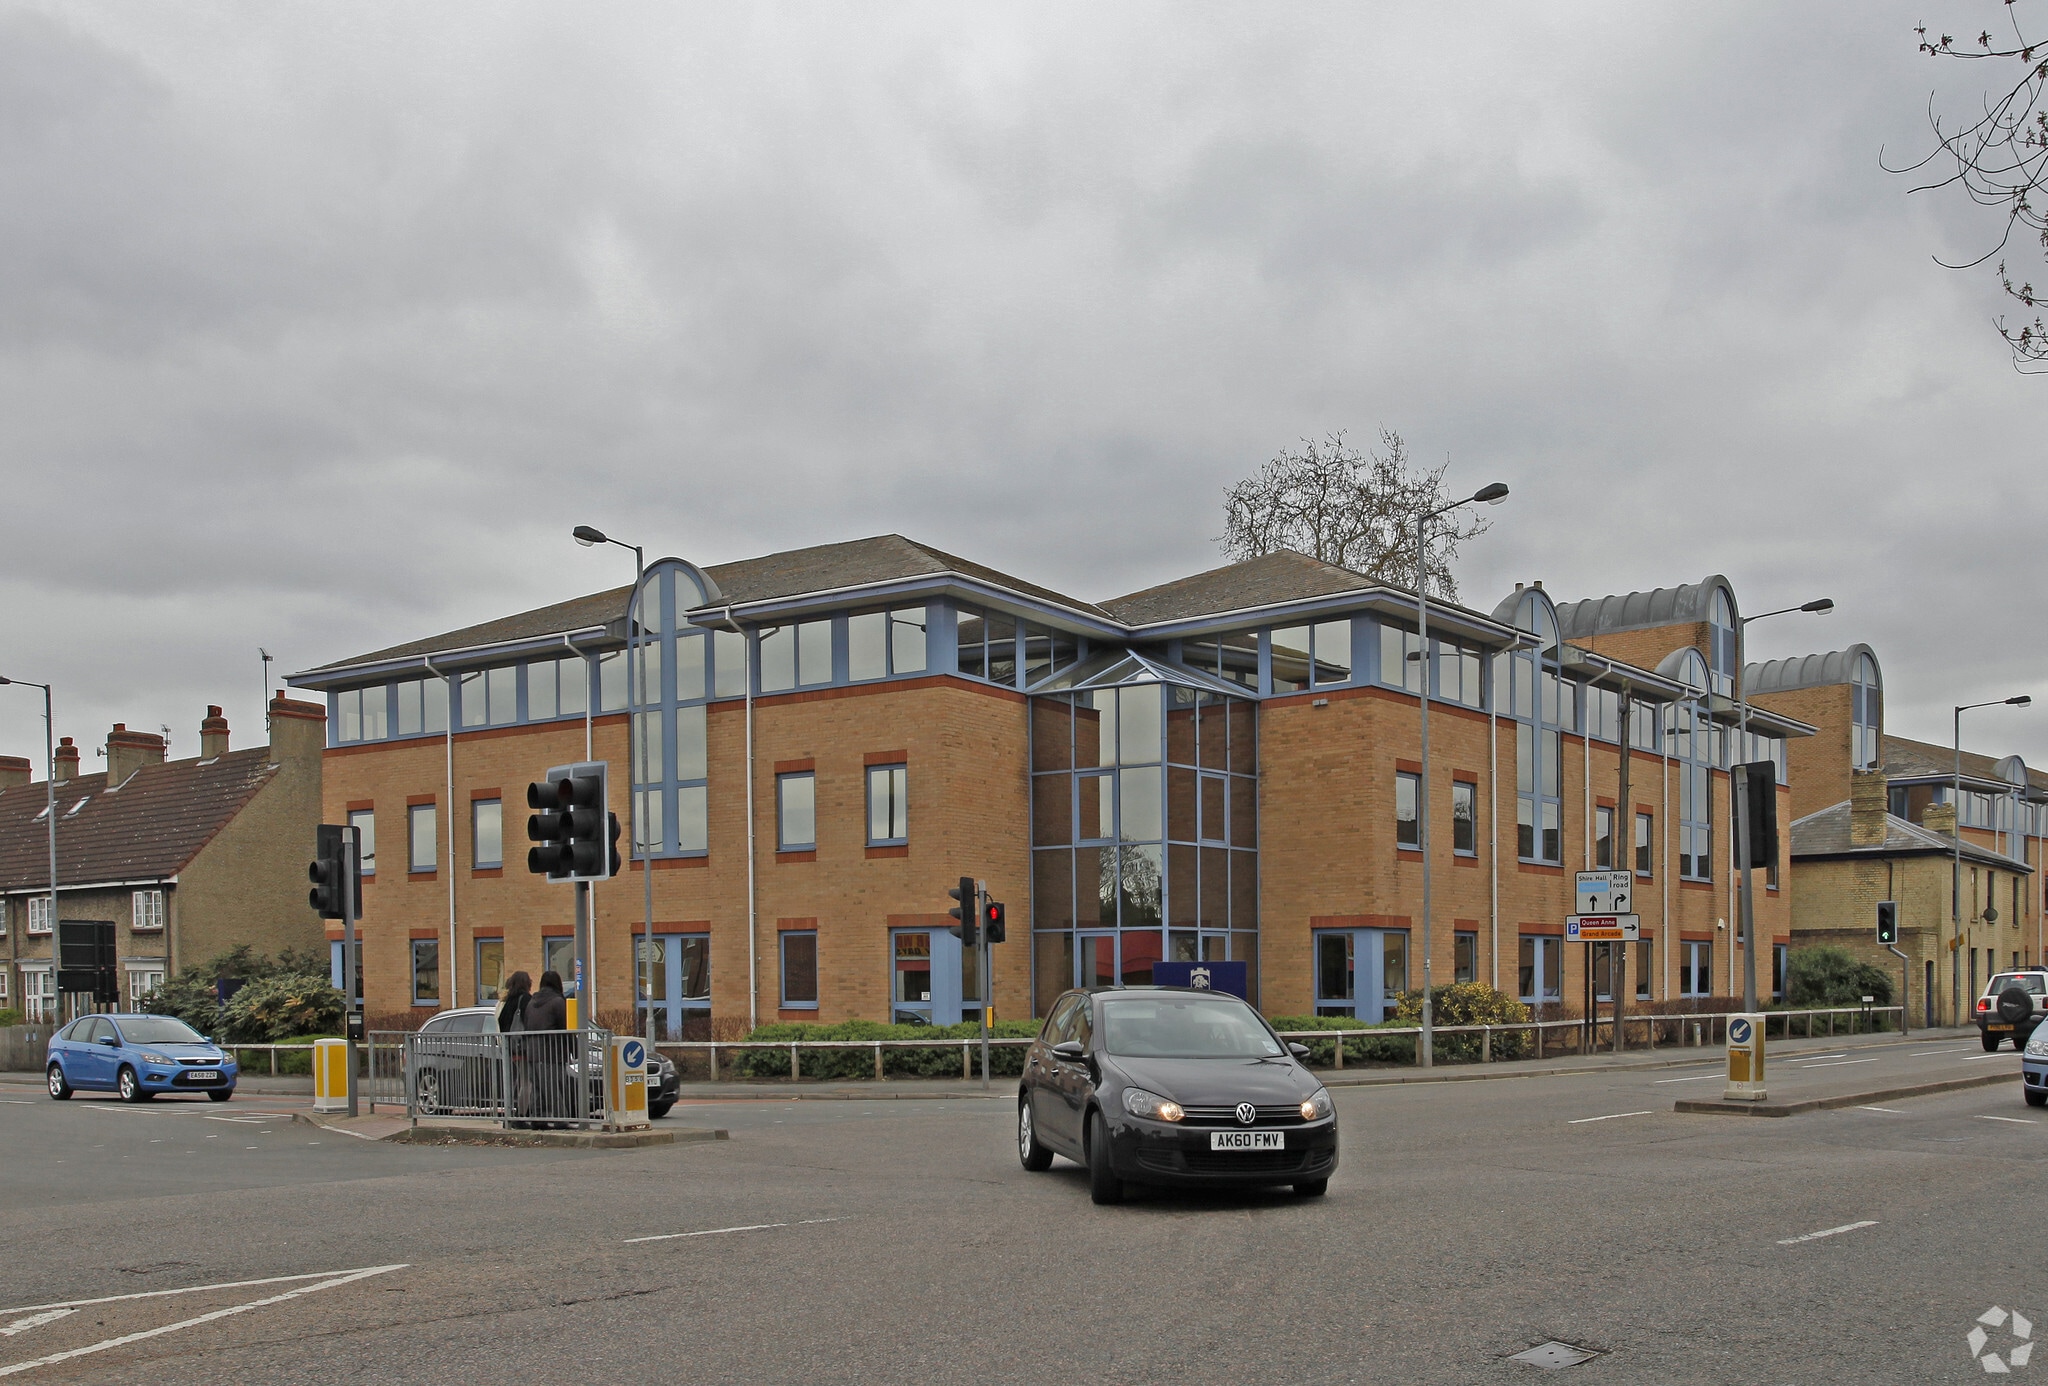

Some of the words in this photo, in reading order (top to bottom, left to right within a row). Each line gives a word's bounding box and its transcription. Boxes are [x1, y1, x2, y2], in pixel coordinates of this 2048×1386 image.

[1570, 924, 1578, 934] P
[1217, 1133, 1251, 1147] AK60
[1254, 1133, 1279, 1147] FMV
